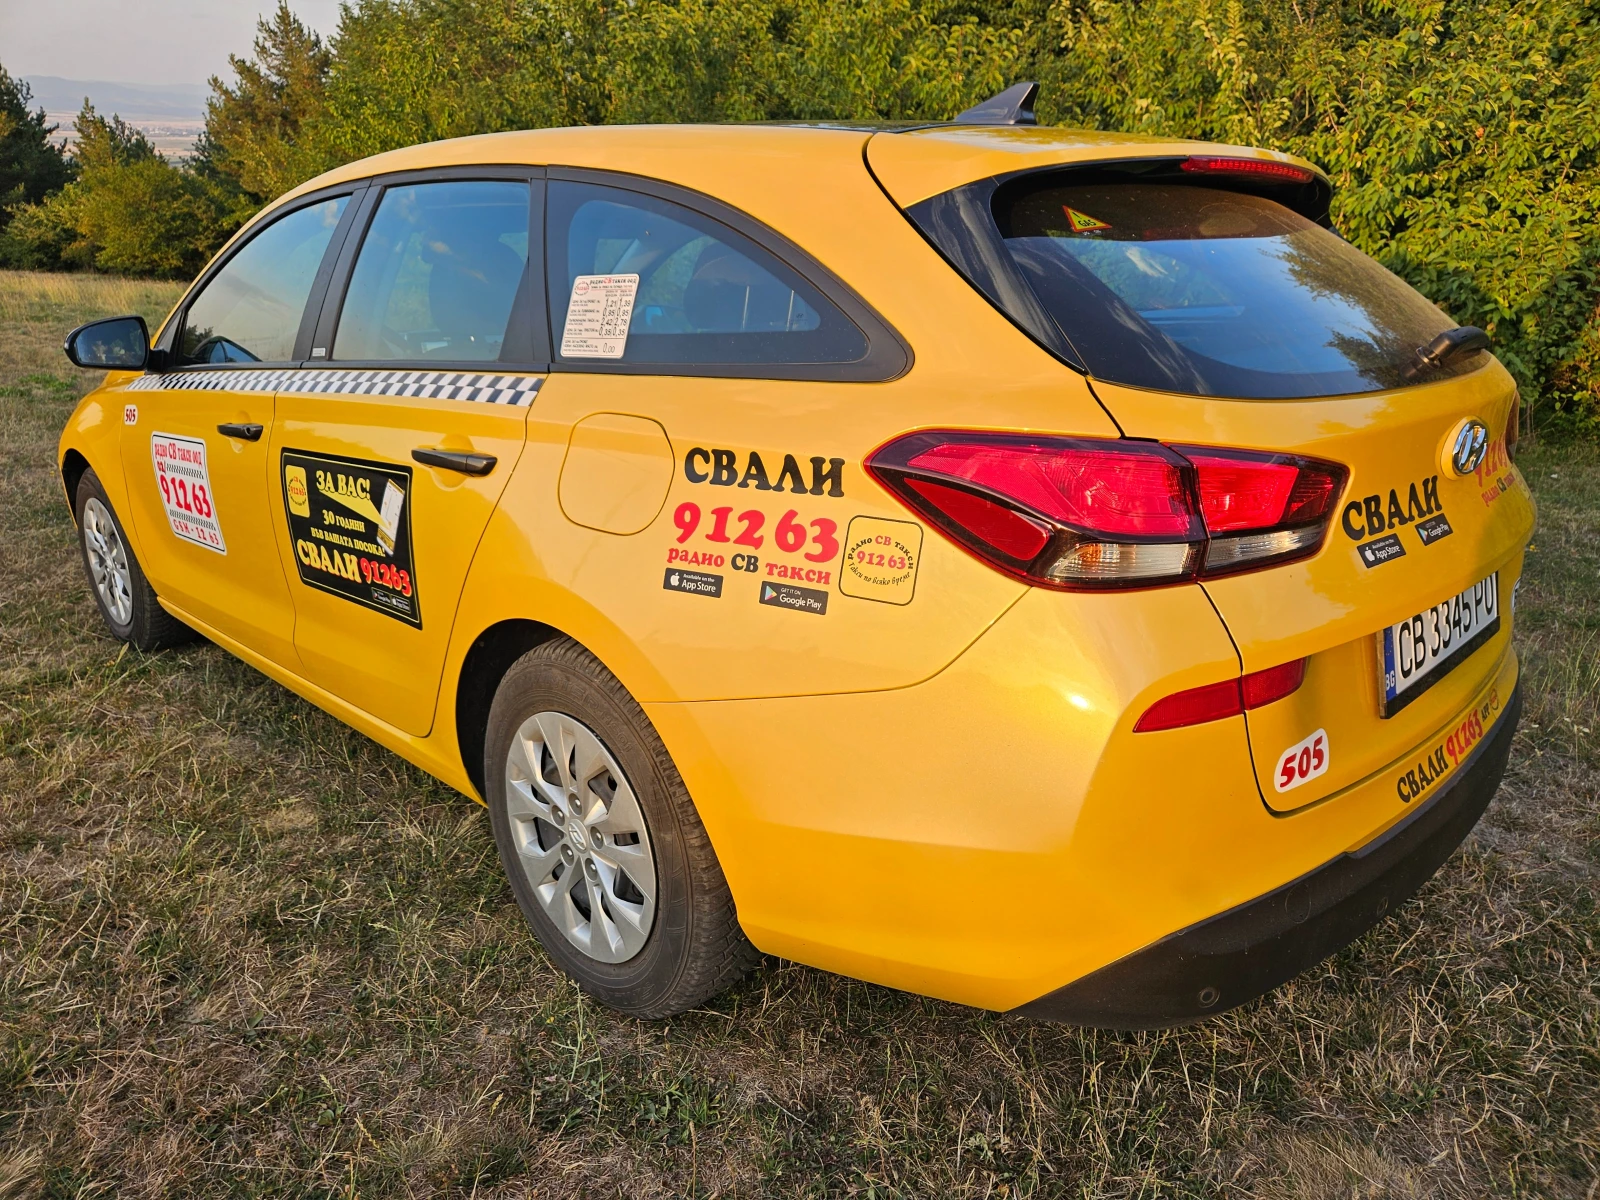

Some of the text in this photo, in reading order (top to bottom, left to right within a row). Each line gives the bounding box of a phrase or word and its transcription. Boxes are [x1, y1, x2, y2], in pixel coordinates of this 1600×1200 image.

[1077, 219, 1097, 227] GAS
[125, 408, 136, 423] 505
[315, 469, 371, 500] ЗА ВАС!
[684, 446, 846, 498] СВАЛИ
[322, 509, 336, 526] 30
[1341, 475, 1443, 541] СВАЛИ
[310, 526, 386, 557] ВЪВ ВАШАТА ПОСОКА!
[1428, 525, 1442, 537] Google
[296, 538, 413, 597] СВАЛИ 91263
[666, 547, 832, 585] радио СВ такси
[847, 535, 914, 570] радио СВ такси
[1375, 545, 1401, 560] App Store
[681, 579, 717, 593] App Store
[682, 573, 702, 581] Available
[779, 593, 822, 611] Google Play
[1429, 591, 1473, 658] 3345
[1385, 670, 1396, 691] BG
[1279, 735, 1325, 788] 505
[1396, 744, 1450, 803] СВАЛИ
[1446, 708, 1484, 767] 91263
